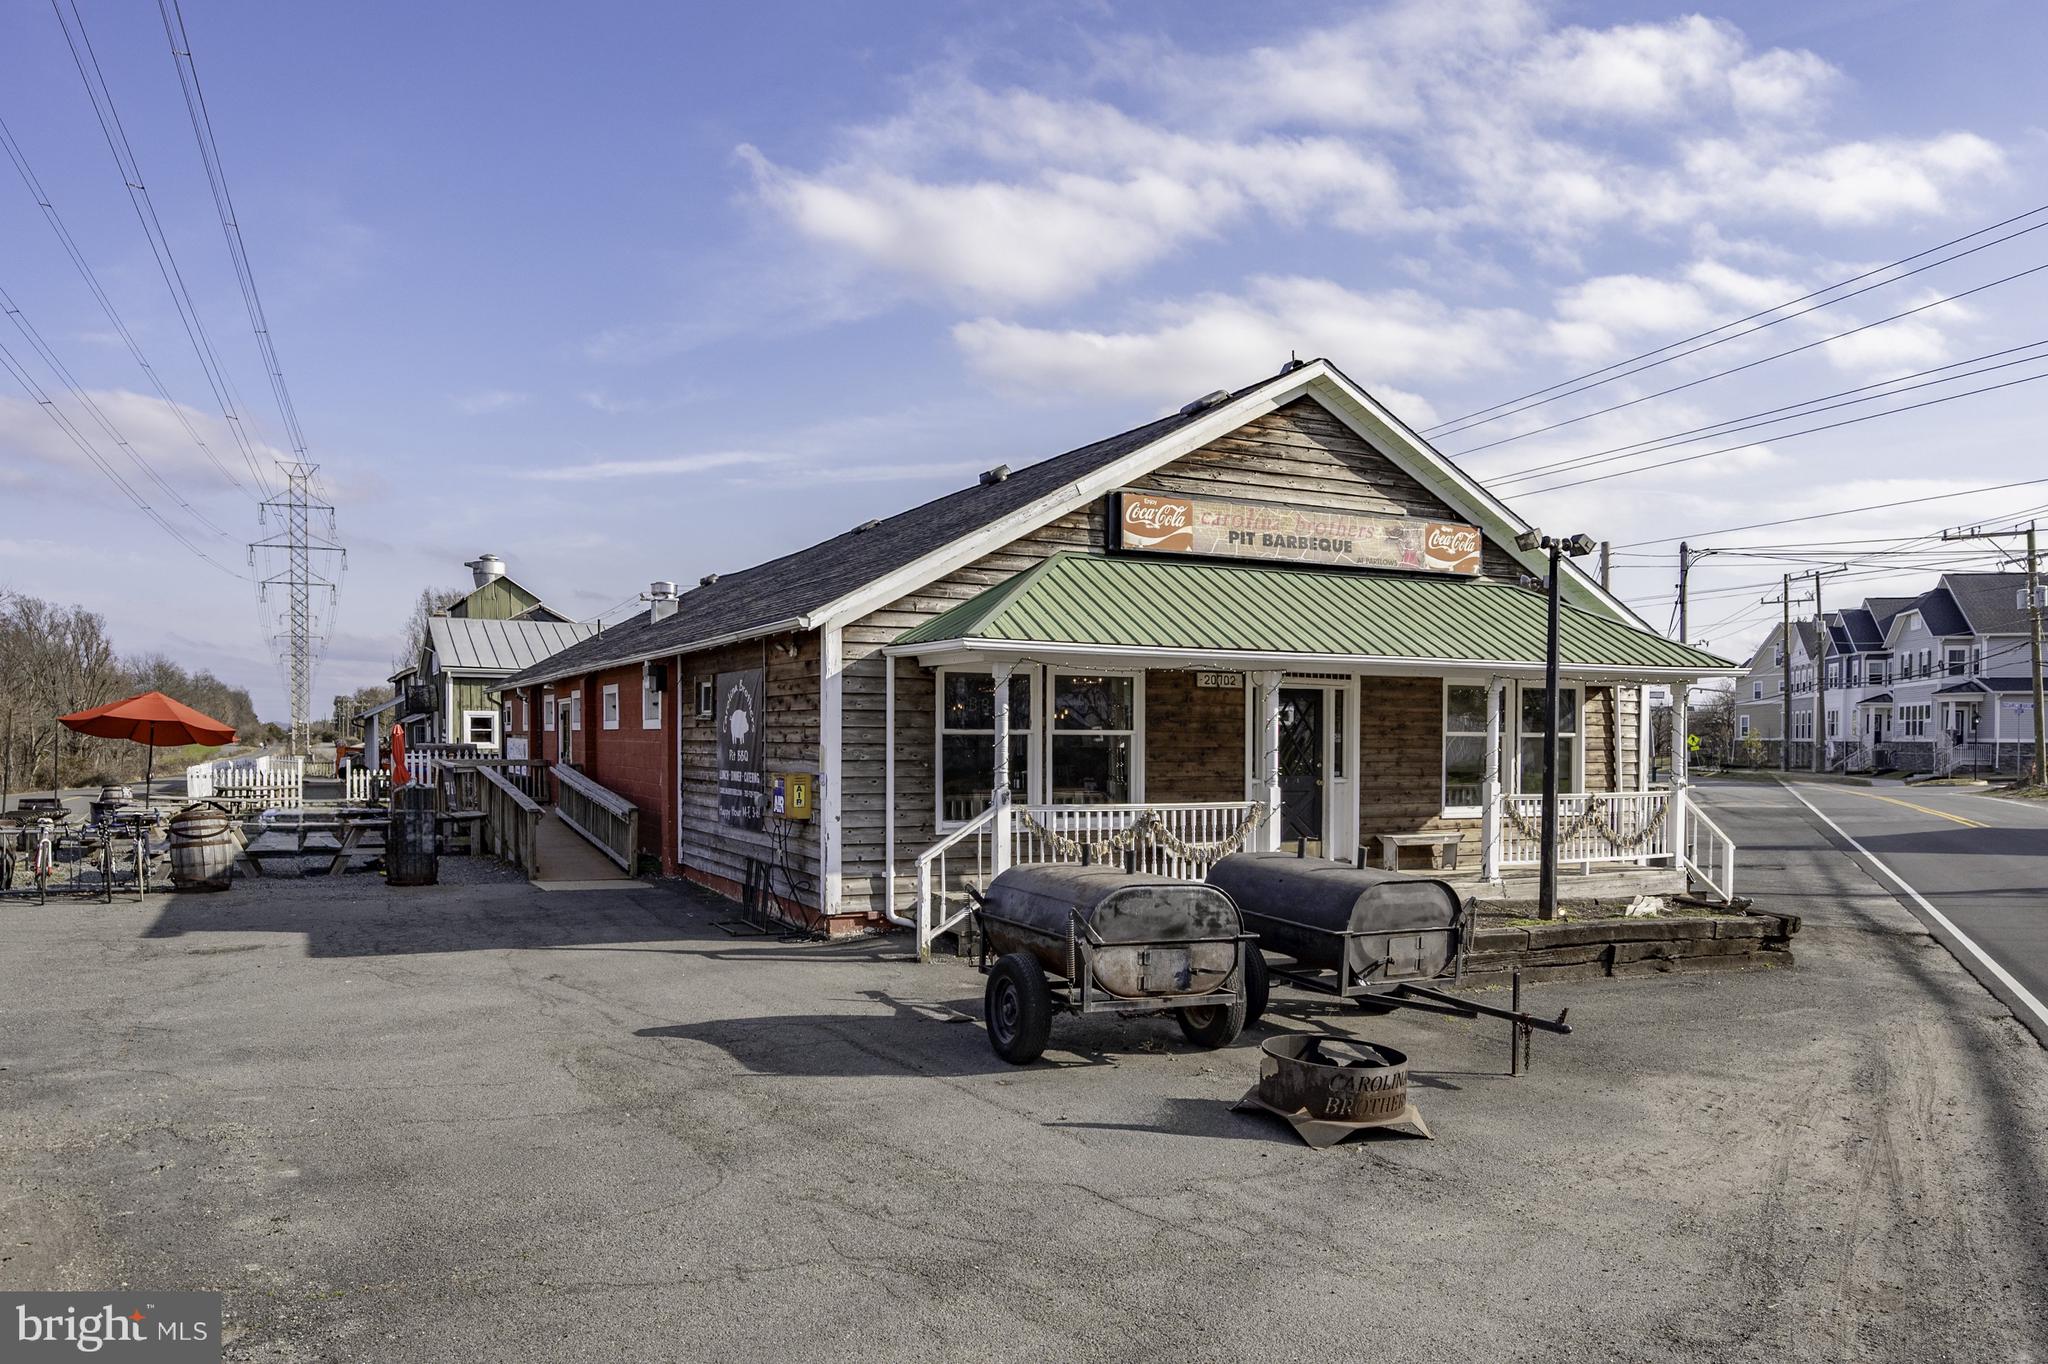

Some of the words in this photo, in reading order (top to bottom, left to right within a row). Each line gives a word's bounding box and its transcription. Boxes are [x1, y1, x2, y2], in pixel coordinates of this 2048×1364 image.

[1296, 515, 1375, 540] brothers
[1228, 530, 1256, 546] PIT
[1262, 533, 1353, 554] BARBEQUE
